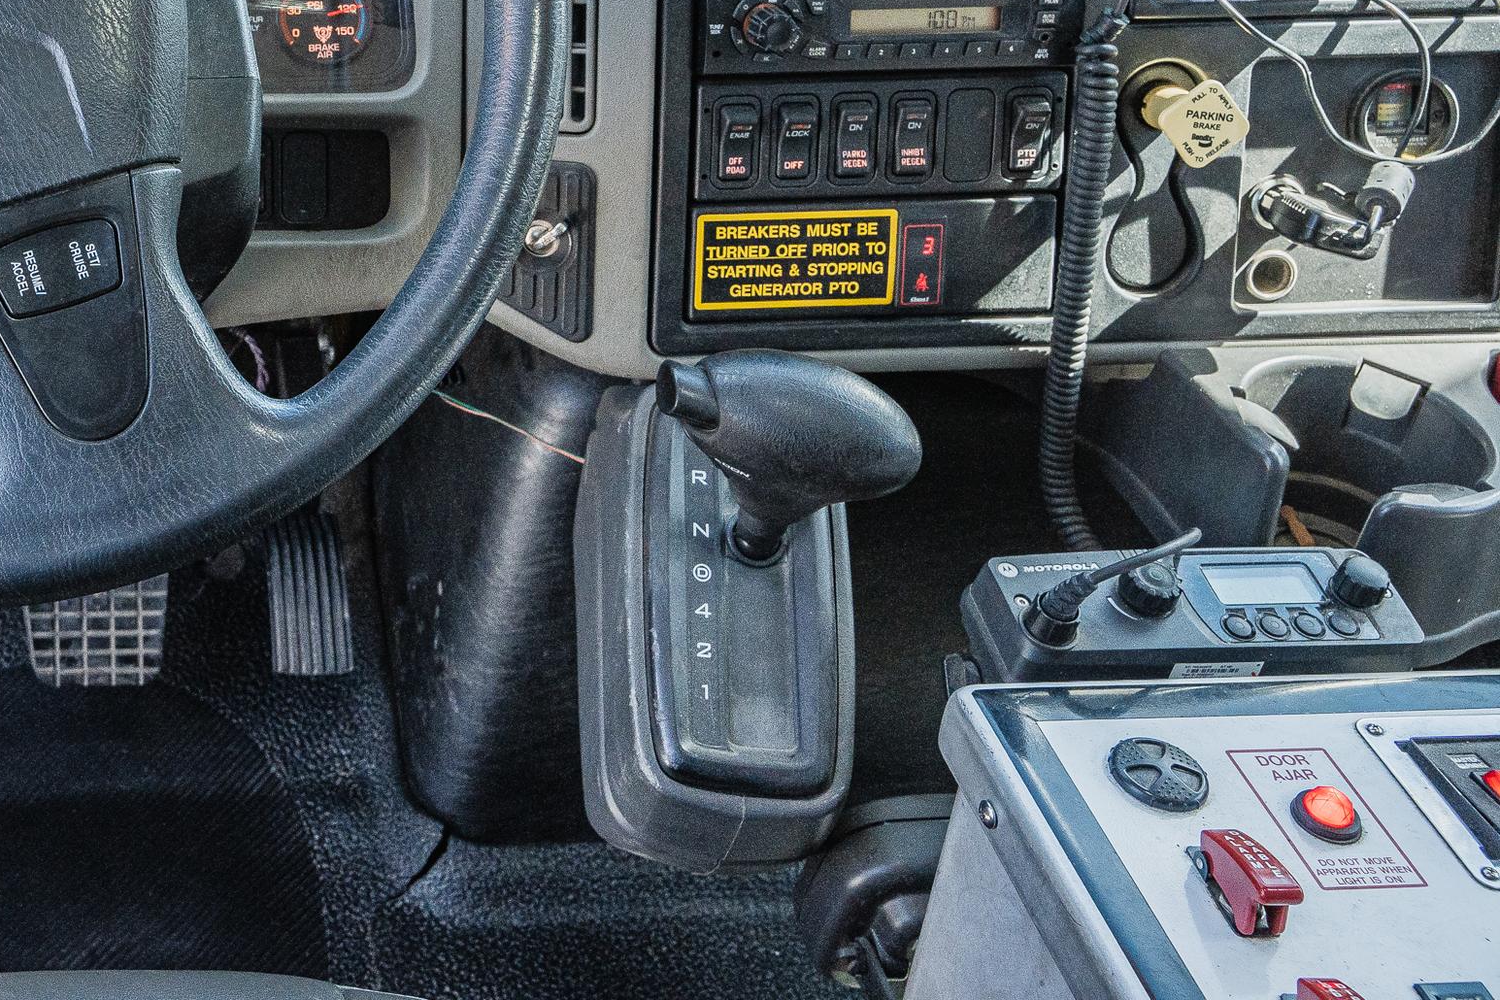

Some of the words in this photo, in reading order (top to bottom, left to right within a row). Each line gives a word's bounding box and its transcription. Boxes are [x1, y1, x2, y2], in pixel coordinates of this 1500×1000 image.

[292, 29, 300, 38] 0
[335, 27, 354, 35] 150
[308, 44, 339, 52] BRAKE
[1191, 92, 1207, 103] PULL
[1218, 94, 1232, 110] APPLY
[1186, 110, 1234, 122] PARKING
[1193, 122, 1221, 130] BRAKE
[842, 150, 867, 158] PARKD
[901, 148, 924, 156] INHIBT
[1017, 149, 1037, 157] PTO
[1182, 142, 1194, 156] PUSH
[1205, 138, 1231, 158] RELEASE
[728, 157, 743, 165] OFF
[784, 161, 804, 169] DIFF
[843, 159, 867, 168] REGEN
[901, 157, 925, 166] REGEN
[1017, 159, 1035, 167] OFF
[726, 166, 745, 174] ROAD
[716, 225, 800, 240] BREAKERS
[806, 223, 851, 237] MUST
[857, 222, 878, 236] BE
[85, 243, 101, 267] SET/
[706, 246, 769, 260] TURNED
[776, 244, 807, 258] OFF
[813, 243, 860, 257] PRIOR
[866, 241, 886, 255] TO
[68, 241, 90, 280] CRUISE
[22, 249, 47, 296] RESUME/
[707, 264, 782, 278] STARTING
[789, 264, 799, 276] &
[807, 261, 884, 276] STOPPING
[10, 261, 30, 297] ACCEL
[729, 282, 822, 297] GENERATOR
[828, 281, 860, 294] PTO
[691, 470, 708, 485] R
[693, 522, 710, 538] N
[1023, 562, 1101, 573] MOTOROLA
[695, 603, 712, 619] 4
[696, 642, 712, 658] 2
[1254, 755, 1310, 767] DOOR
[1271, 769, 1318, 781] AJAR
[1225, 836, 1264, 869] ALARM
[1228, 830, 1285, 878] DISABLE
[1318, 859, 1335, 867] DO
[1338, 858, 1359, 866] NOT
[1365, 857, 1395, 865] MOVE
[1316, 867, 1374, 877] APPARATUS
[1379, 866, 1413, 874] WHEN
[1336, 877, 1366, 886] LIGHT
[1386, 875, 1405, 884] ON!
